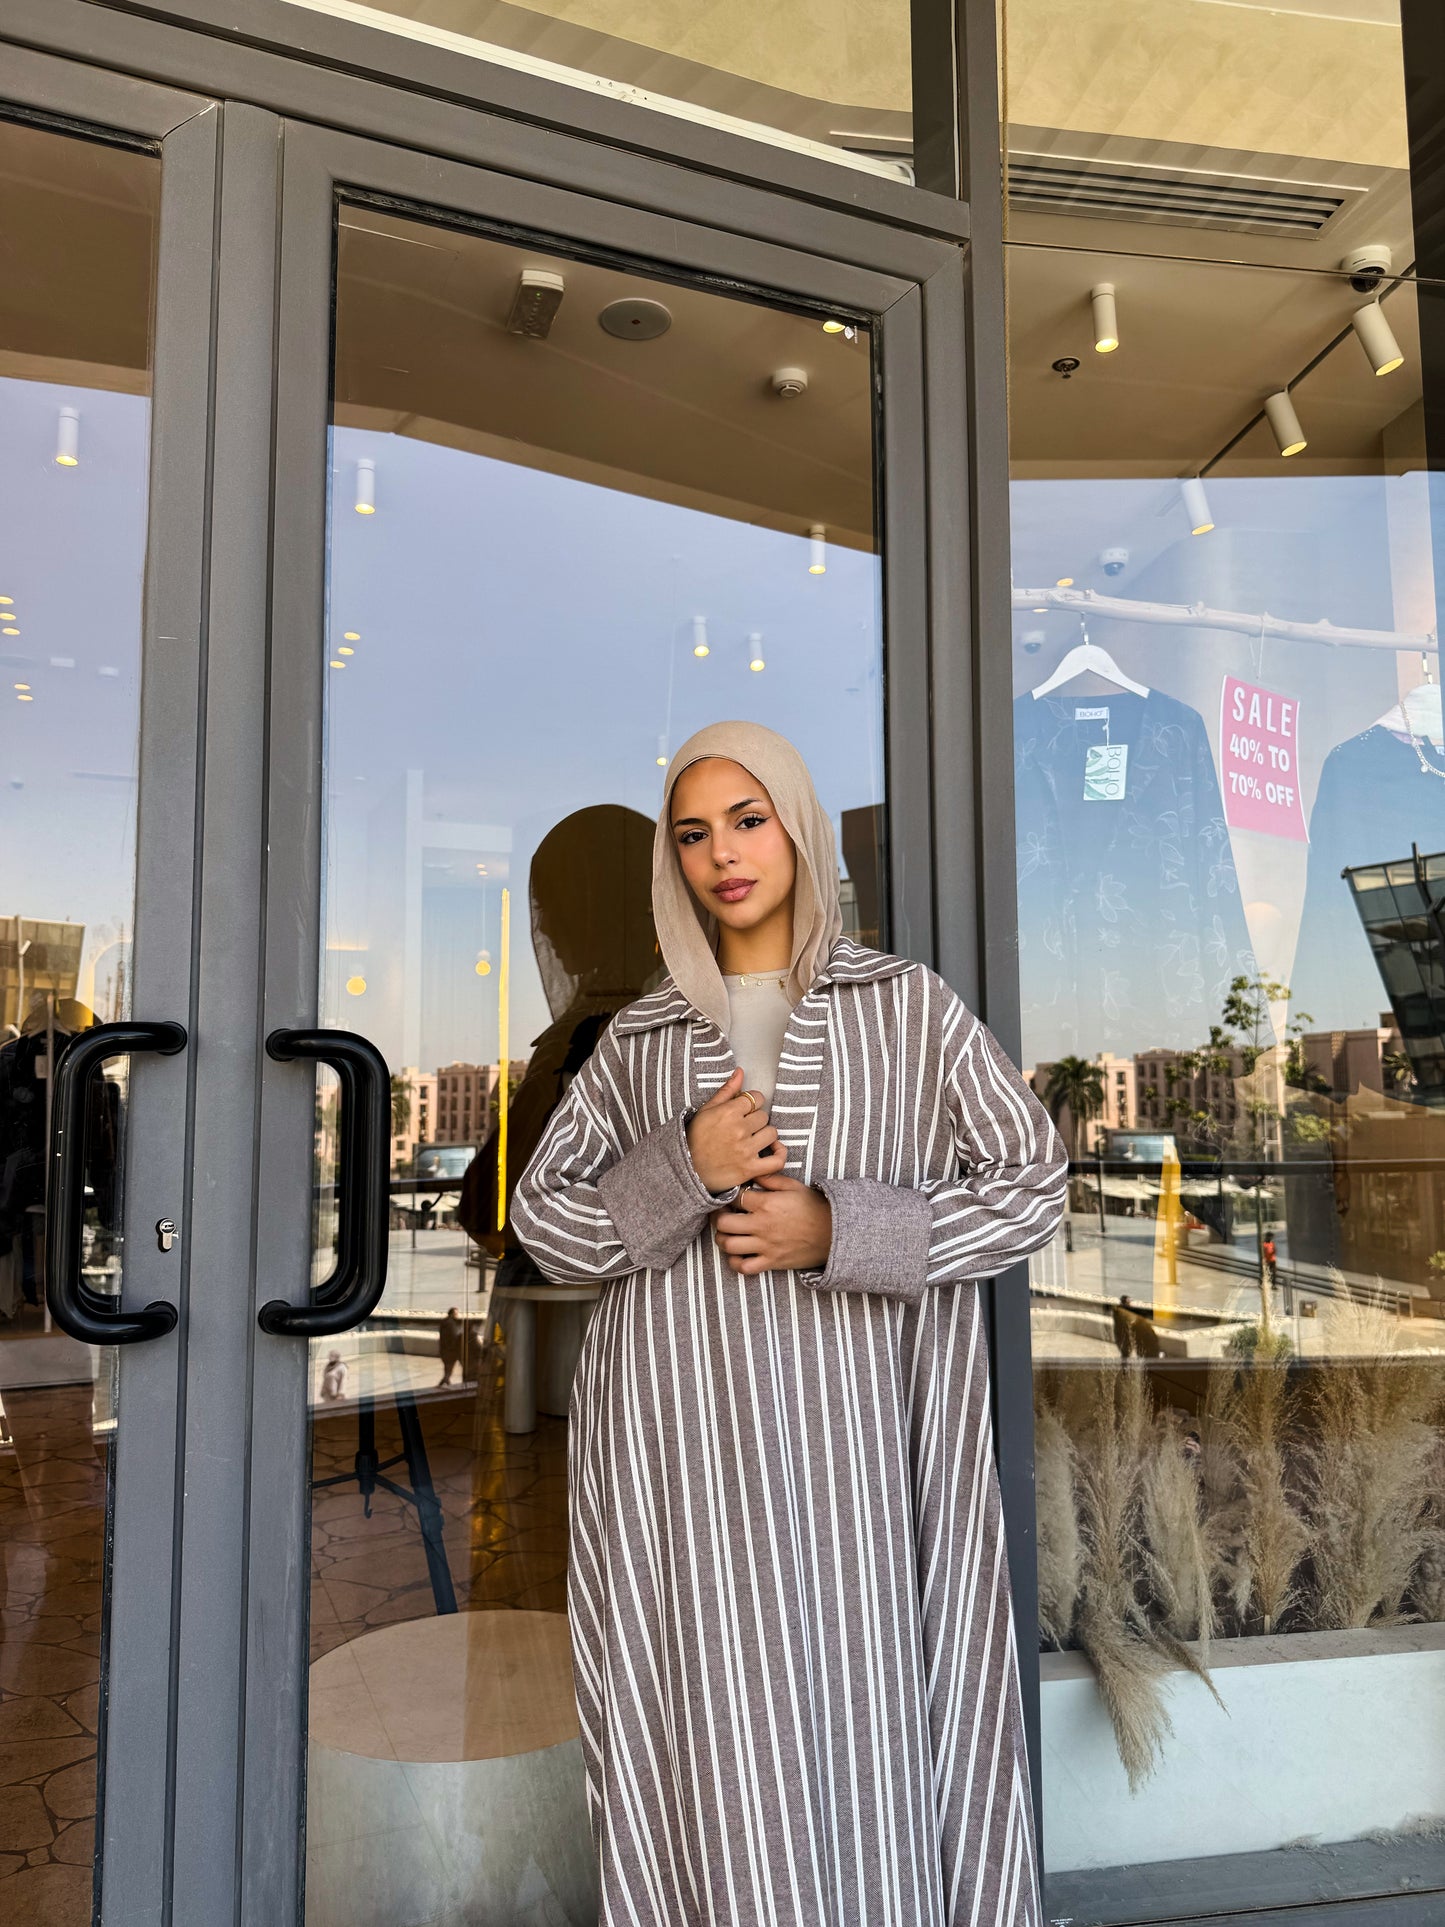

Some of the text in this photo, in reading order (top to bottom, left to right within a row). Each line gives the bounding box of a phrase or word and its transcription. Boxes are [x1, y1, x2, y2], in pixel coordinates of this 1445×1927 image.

[1232, 686, 1292, 737] SALE
[1229, 733, 1290, 772] 40% TO
[1228, 771, 1294, 808] 70% OFF
